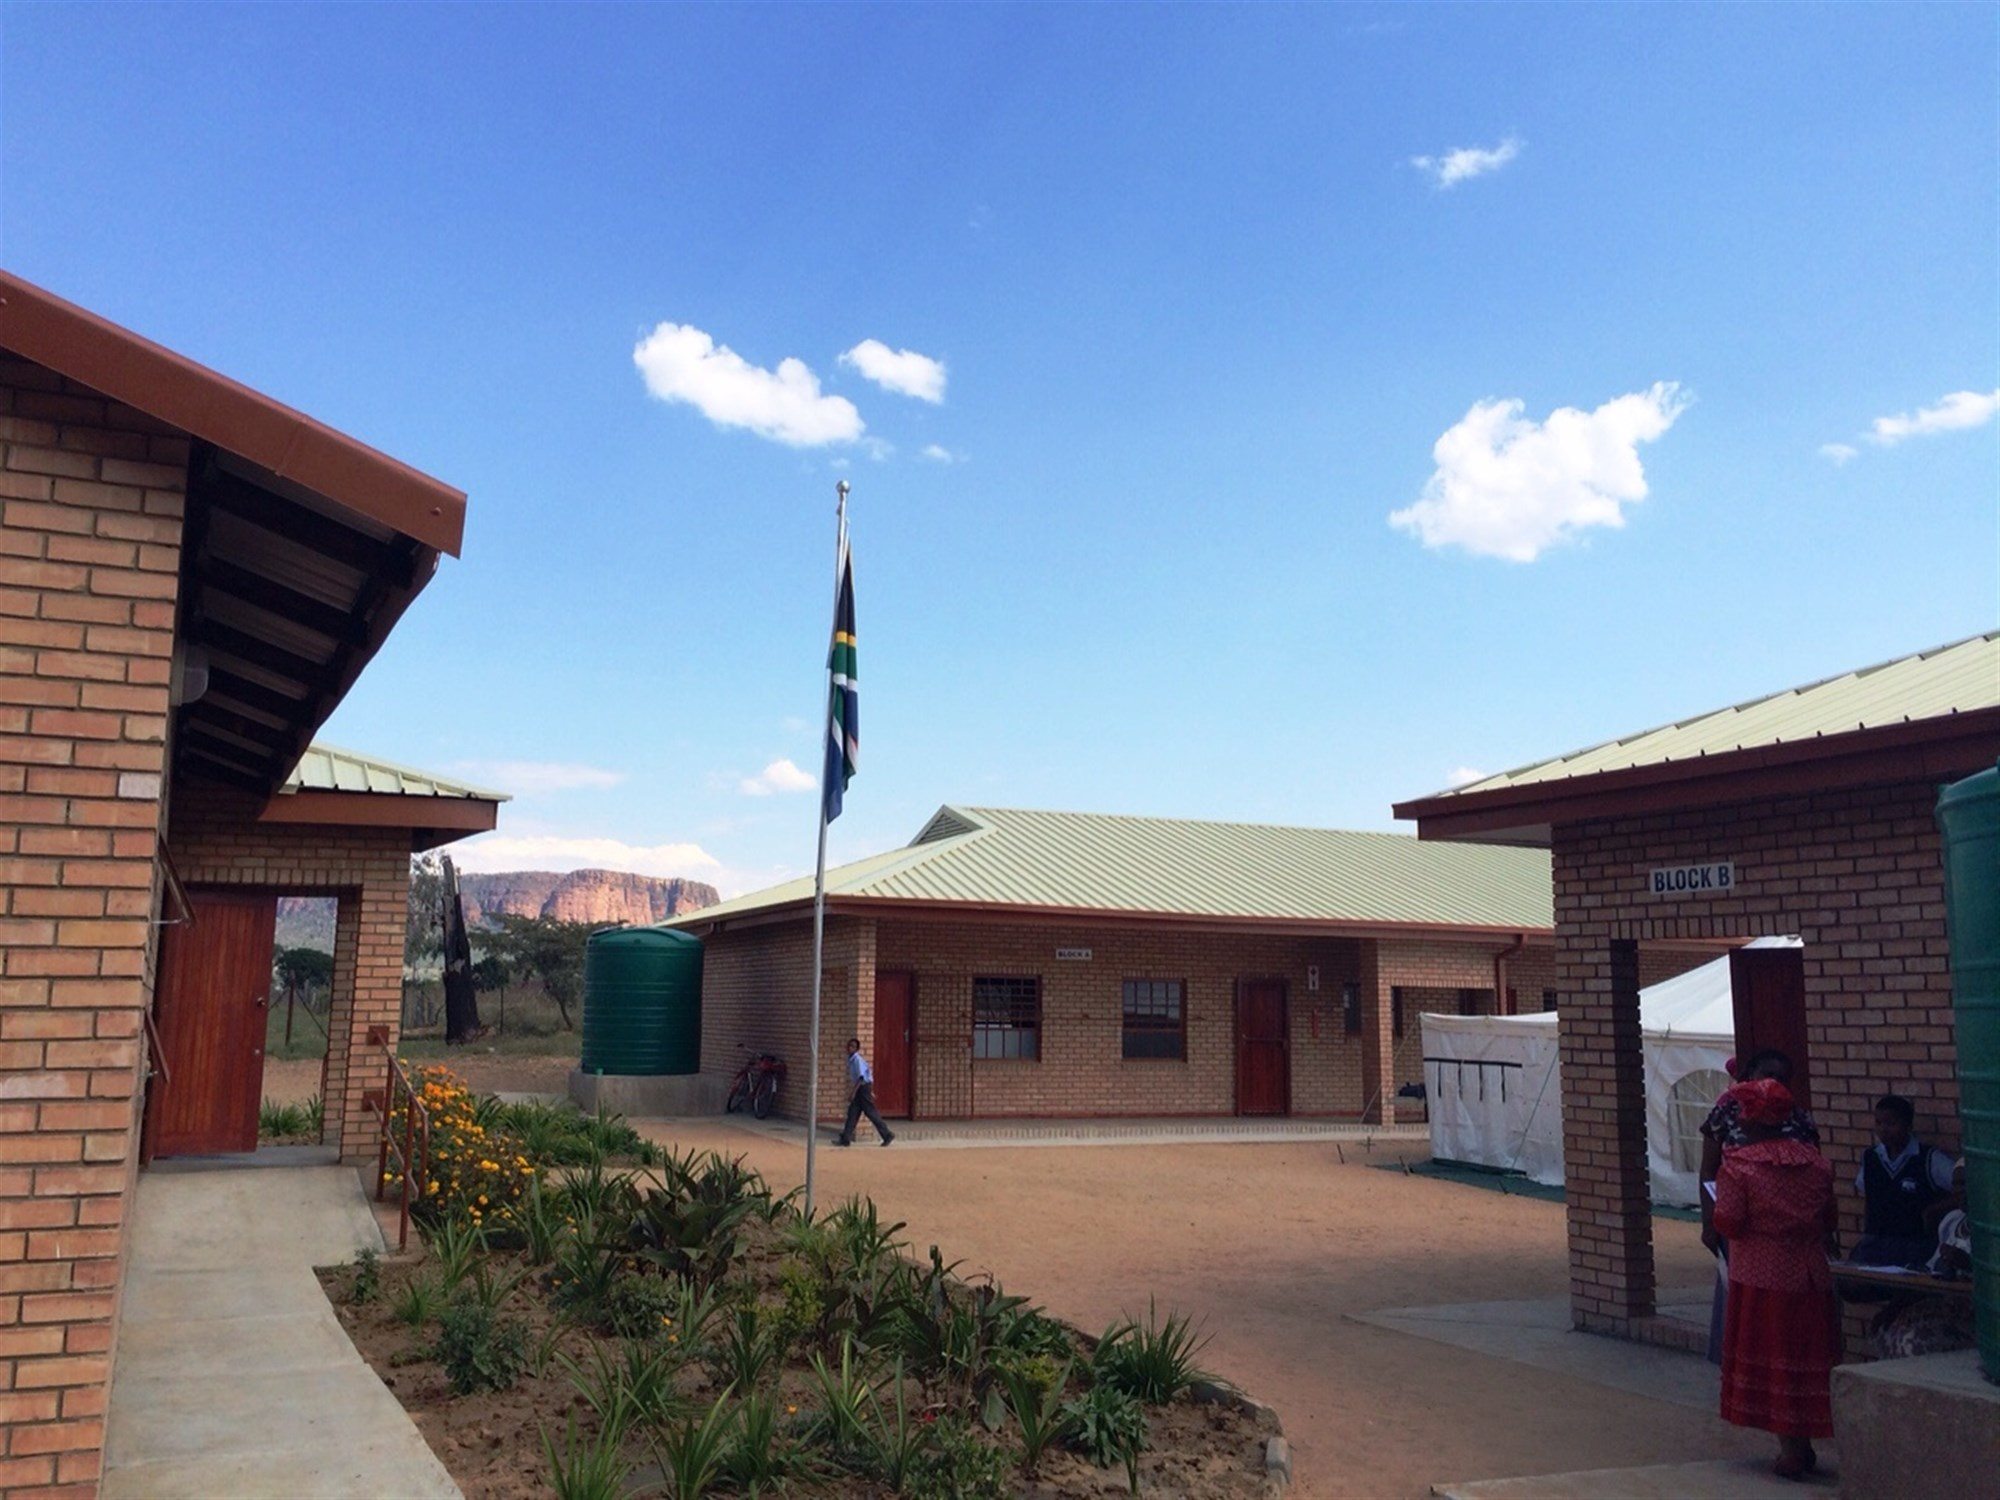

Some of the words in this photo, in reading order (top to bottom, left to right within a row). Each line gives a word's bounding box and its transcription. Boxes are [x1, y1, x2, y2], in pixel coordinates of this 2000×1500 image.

[1654, 866, 1713, 893] BLOCK
[1718, 865, 1730, 887] B
[1057, 950, 1083, 958] BLOCK
